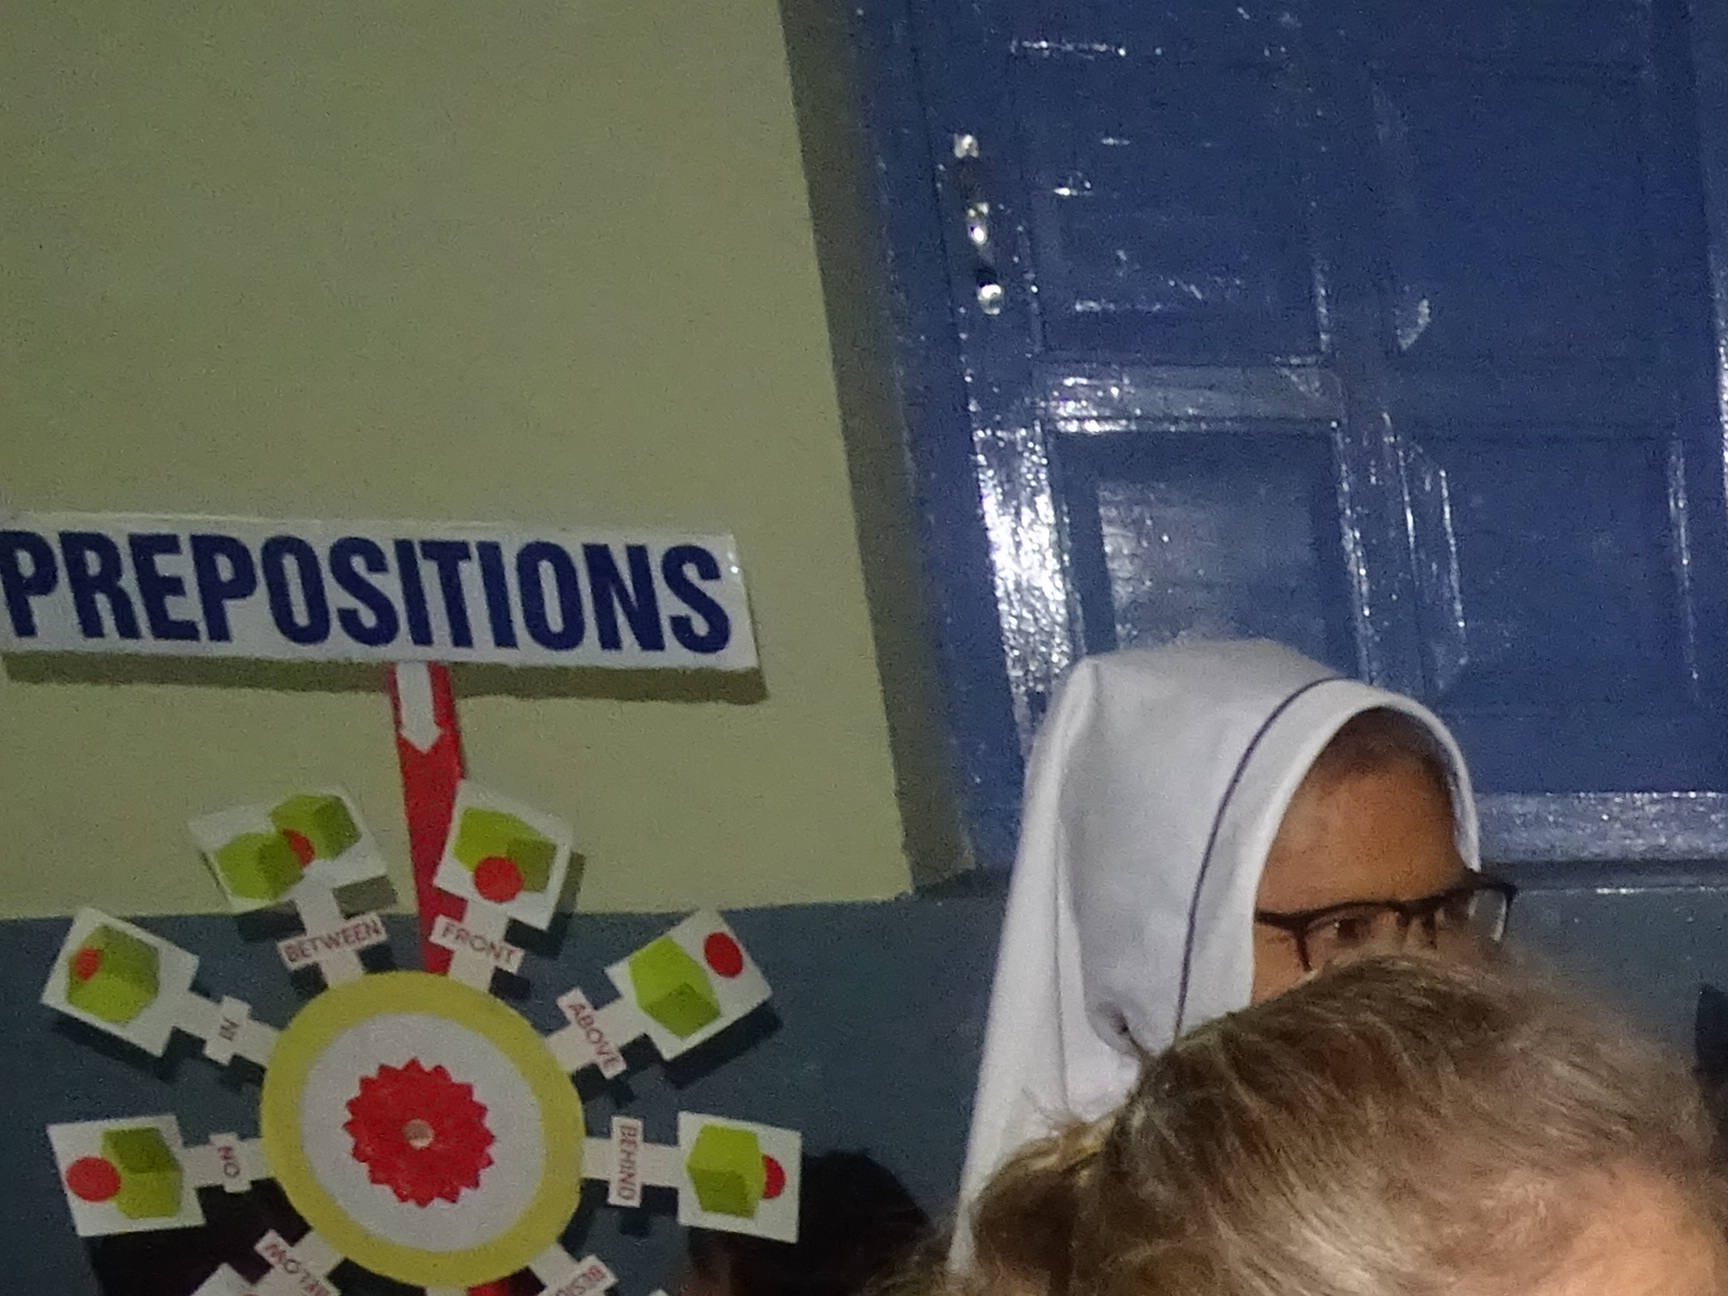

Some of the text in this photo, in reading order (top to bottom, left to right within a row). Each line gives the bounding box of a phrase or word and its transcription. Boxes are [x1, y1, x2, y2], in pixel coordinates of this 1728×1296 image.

[0, 531, 730, 656] PREPOSITIONS
[283, 917, 383, 968] BETWEEN
[440, 921, 520, 966] FRONT
[566, 1000, 623, 1073] ABOVE
[620, 1125, 640, 1203] BEHIND
